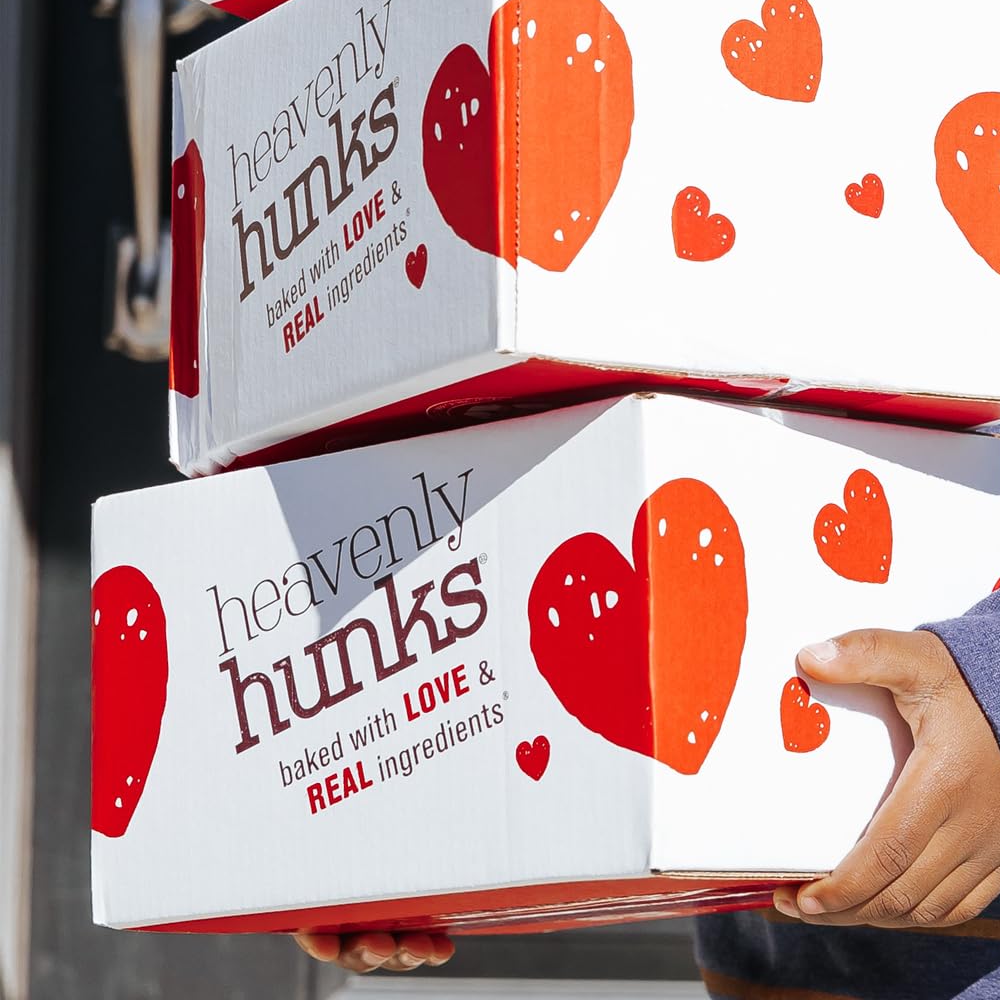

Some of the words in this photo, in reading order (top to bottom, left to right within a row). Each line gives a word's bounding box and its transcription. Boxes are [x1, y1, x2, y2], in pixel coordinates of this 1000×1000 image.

[266, 267, 308, 328] baked
[309, 240, 340, 284] with
[343, 189, 386, 252] LOVE
[391, 180, 402, 205] &
[282, 295, 325, 353] REAL
[205, 468, 474, 657] heavenly
[279, 732, 344, 787] baked
[349, 708, 398, 751] with
[403, 664, 470, 722] LOVE
[478, 660, 496, 686] &
[306, 761, 374, 814] REAL
